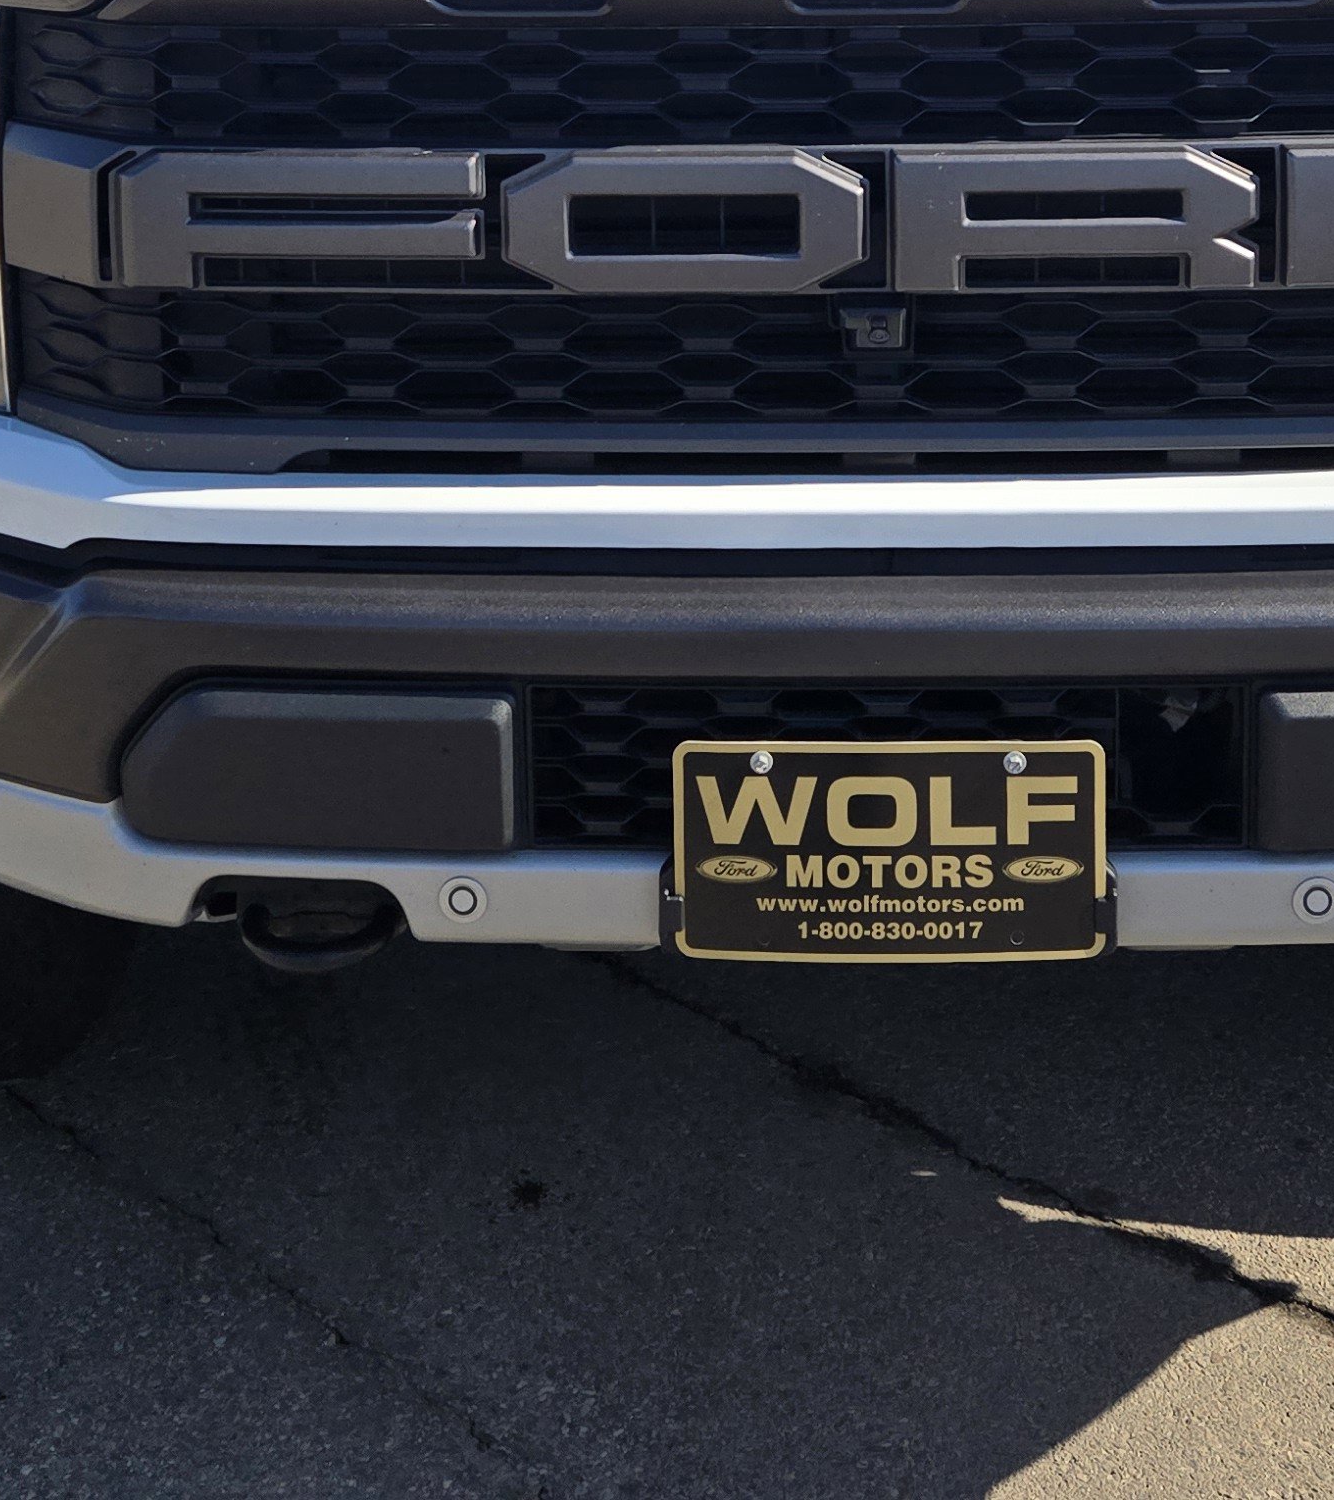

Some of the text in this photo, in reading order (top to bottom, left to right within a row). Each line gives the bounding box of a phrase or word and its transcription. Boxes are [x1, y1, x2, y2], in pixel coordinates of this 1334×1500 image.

[696, 775, 1078, 847] WOLF
[785, 854, 995, 889] MOTORS
[755, 895, 1025, 914] www.wolfmotors.com
[797, 921, 984, 940] 1-800-830-0017
